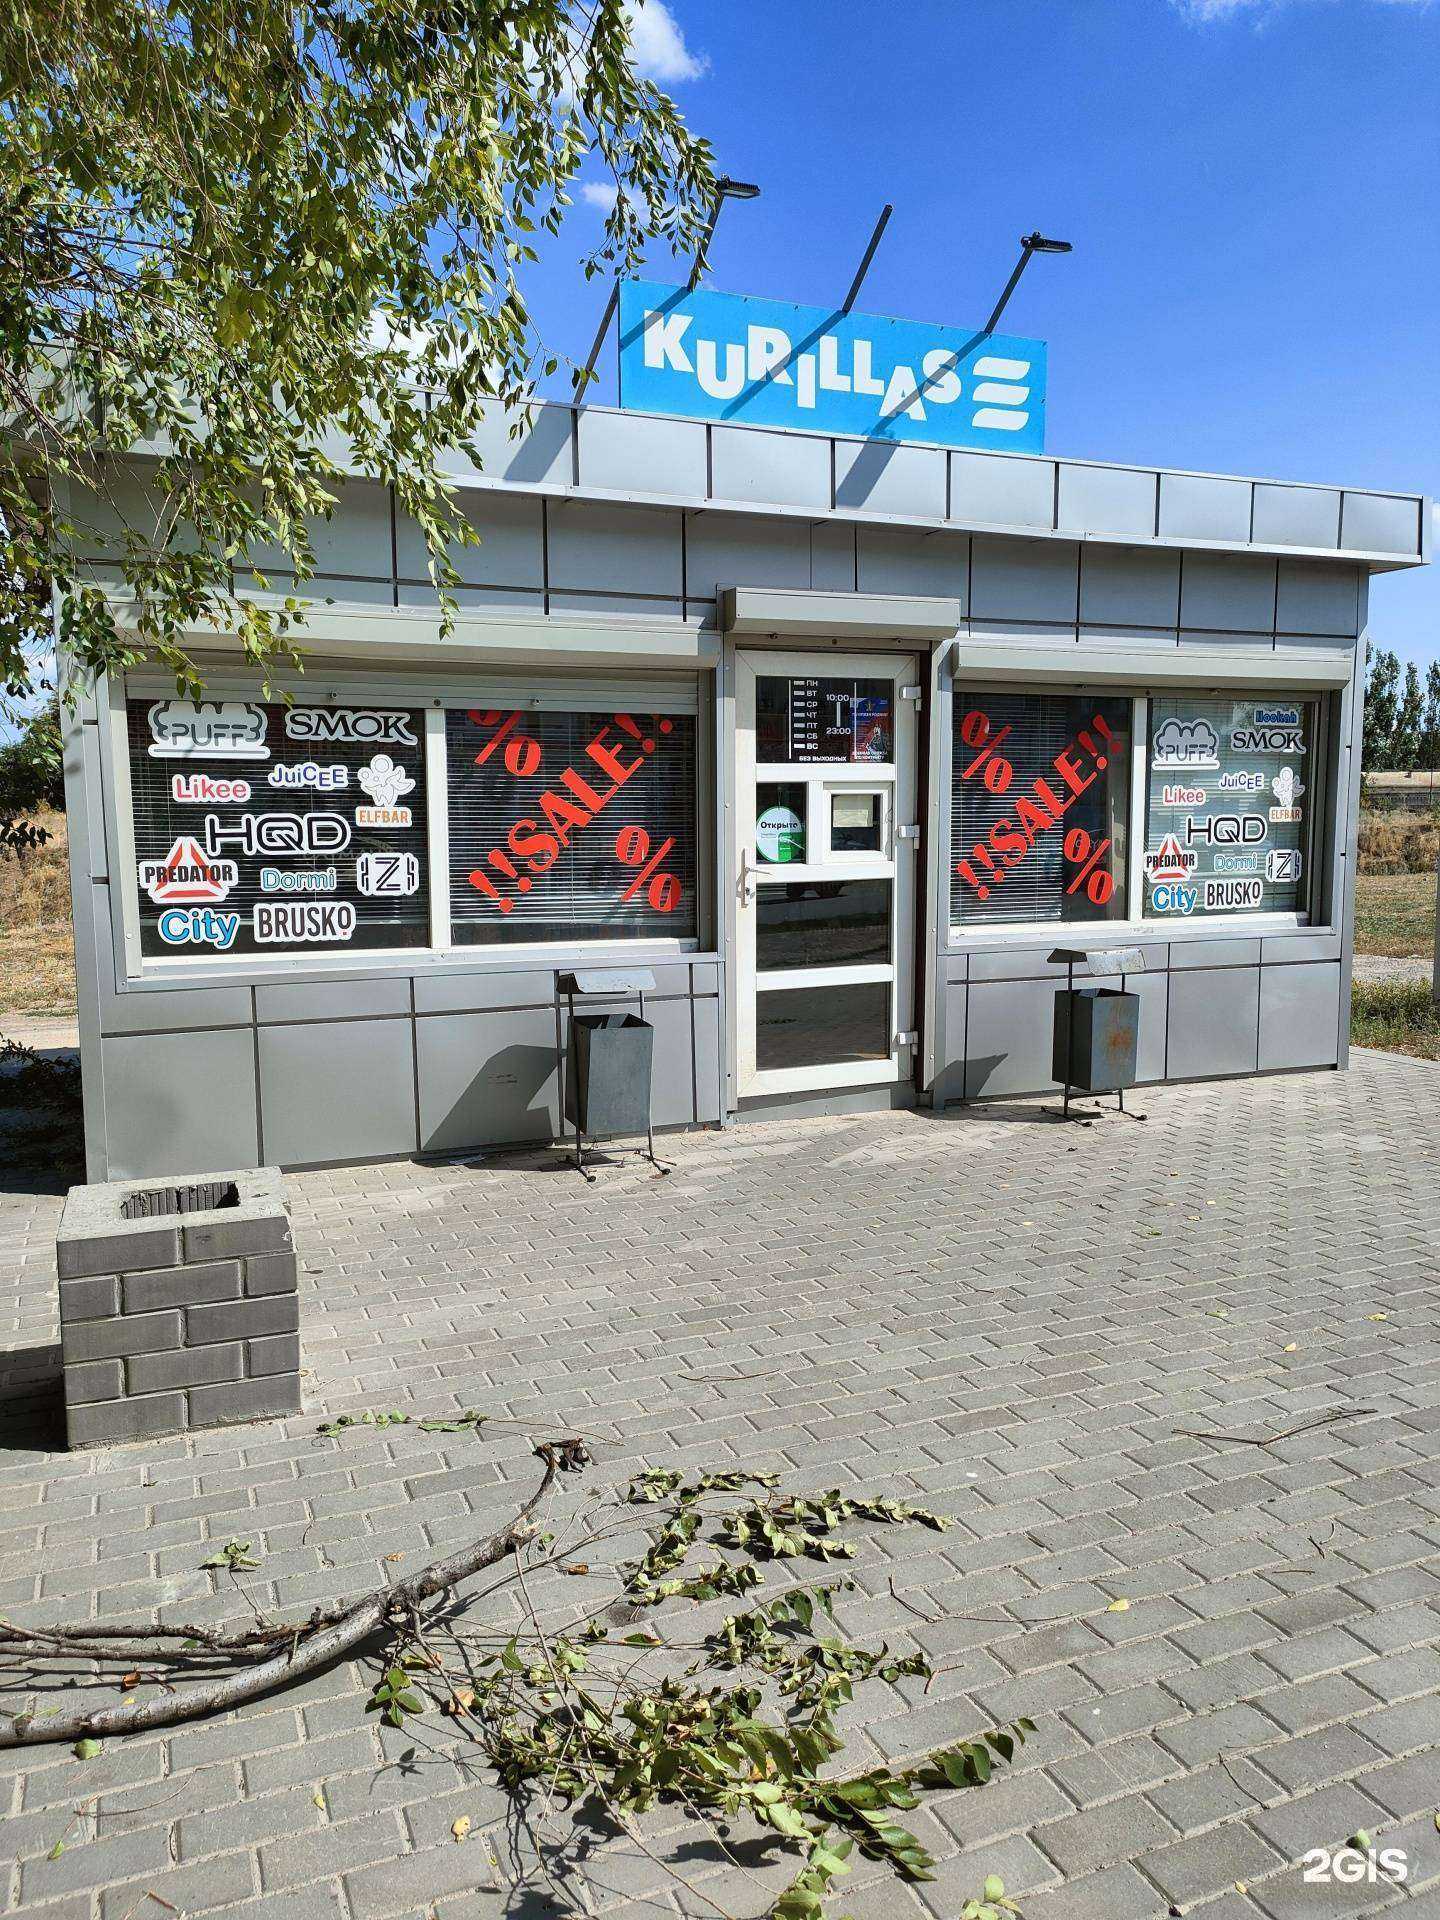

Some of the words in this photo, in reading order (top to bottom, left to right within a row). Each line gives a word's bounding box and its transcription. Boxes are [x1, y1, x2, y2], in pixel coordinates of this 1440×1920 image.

[826, 694, 850, 702] 10:00
[171, 722, 248, 747] PUFF
[288, 711, 416, 743] SMOK
[826, 727, 851, 735] 23:00
[1233, 731, 1305, 752] SMOK
[1165, 743, 1209, 762] PUFF
[176, 778, 248, 799] Likee
[1164, 788, 1204, 803] Likee
[358, 809, 410, 824] ELFBAR
[1271, 809, 1301, 820] ELFBAR
[208, 815, 348, 853] HQD
[760, 821, 798, 830] Открыто
[1187, 816, 1266, 843] HQD
[1146, 853, 1195, 869] PREDATOR
[1215, 853, 1257, 870] Dormi
[144, 863, 233, 884] PREDATOR
[262, 867, 336, 890] Dormi
[1153, 884, 1198, 913] City
[1207, 881, 1261, 905] BRUSKO
[161, 911, 238, 947] City
[258, 905, 351, 938] BRUSKO
